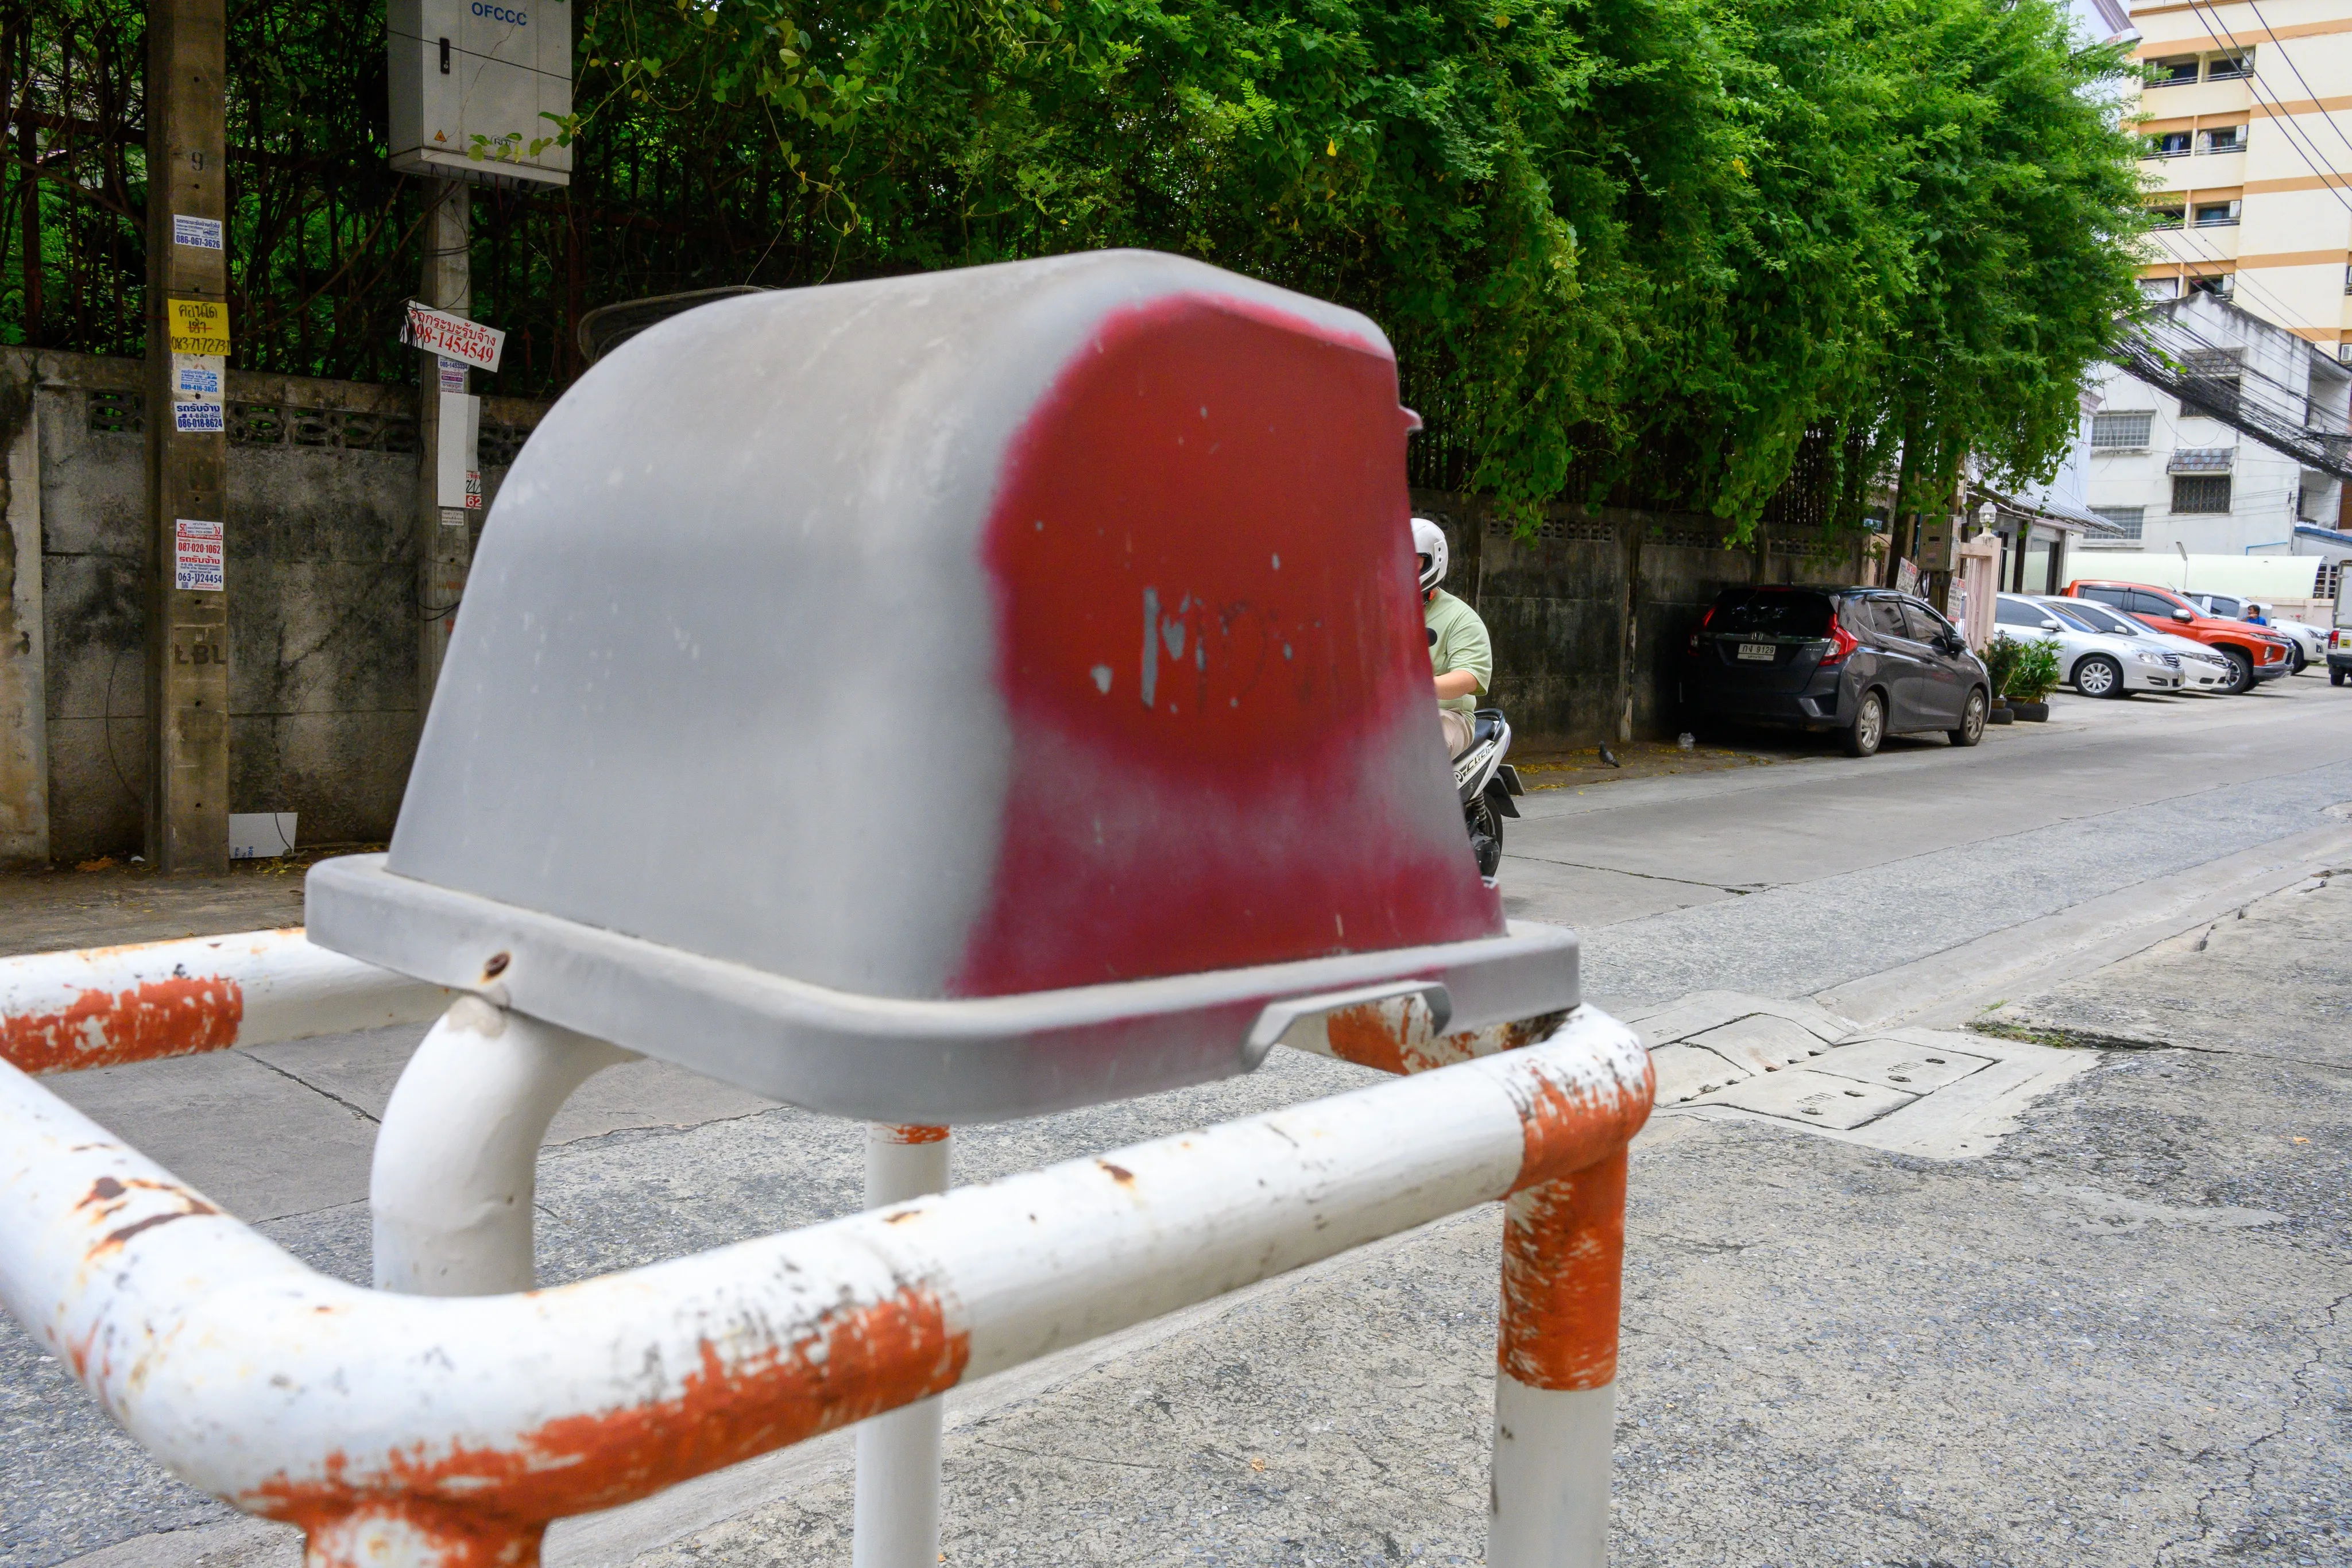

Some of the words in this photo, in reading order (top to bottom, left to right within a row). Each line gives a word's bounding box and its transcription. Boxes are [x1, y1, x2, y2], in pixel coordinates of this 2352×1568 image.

[471, 2, 527, 26] OFCCC
[176, 234, 220, 249] 086-067-3626
[179, 303, 218, 318] คอนโด
[411, 309, 496, 347] รถกระบะรับจ้าง
[440, 361, 467, 369] 085-1453334
[181, 383, 217, 393] 099-416-3824
[177, 403, 220, 412] รถรับจ้าง
[178, 419, 222, 428] 086-018-8624
[467, 496, 482, 506] 62
[179, 555, 220, 564] รถรับจ้าง
[178, 572, 222, 583] 063-1124454
[1757, 646, 1774, 654] 9129
